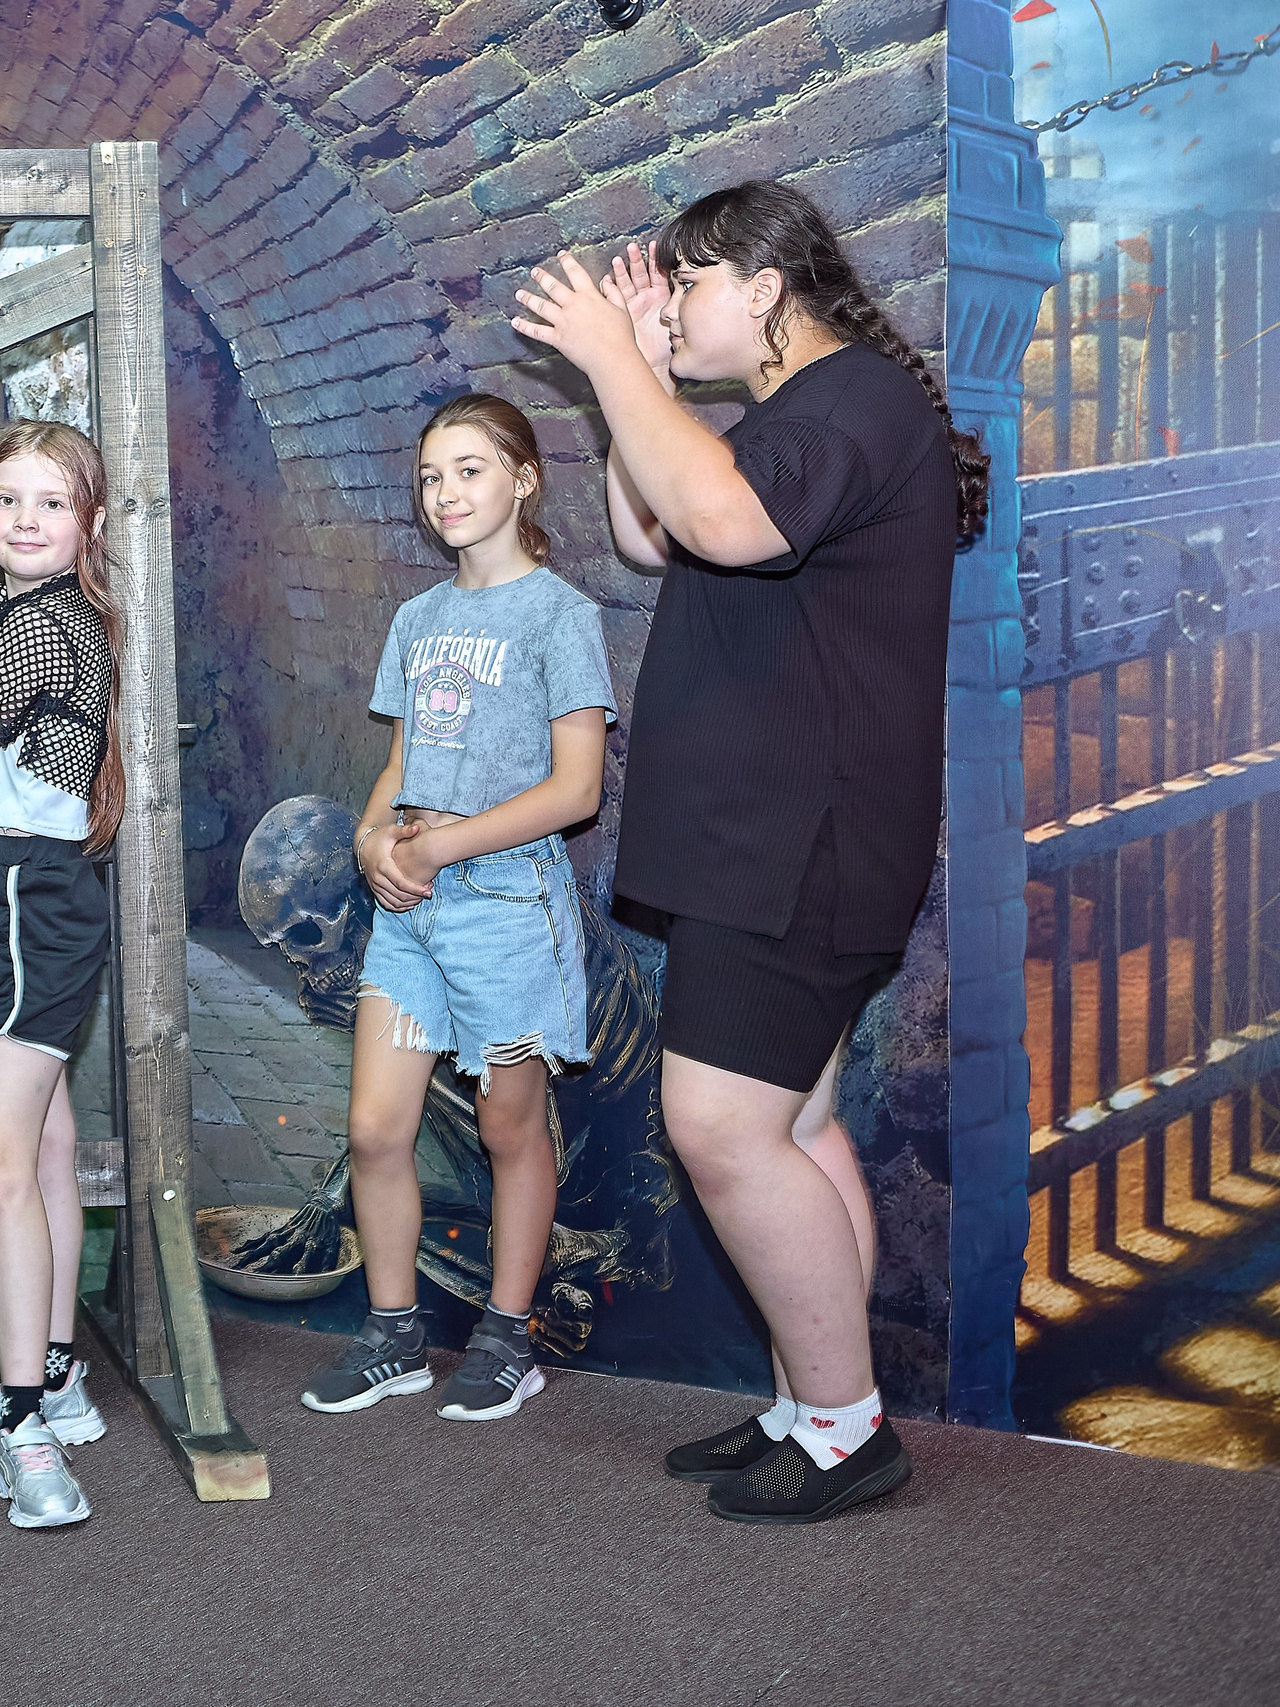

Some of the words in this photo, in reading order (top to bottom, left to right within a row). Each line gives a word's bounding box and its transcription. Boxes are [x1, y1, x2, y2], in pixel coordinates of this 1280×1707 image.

[405, 636, 507, 688] CALIFORNIA
[419, 674, 434, 694] LOS
[439, 667, 471, 699] ANGELES
[429, 688, 457, 713] 89
[419, 711, 439, 731] WEST
[440, 716, 463, 732] COAST
